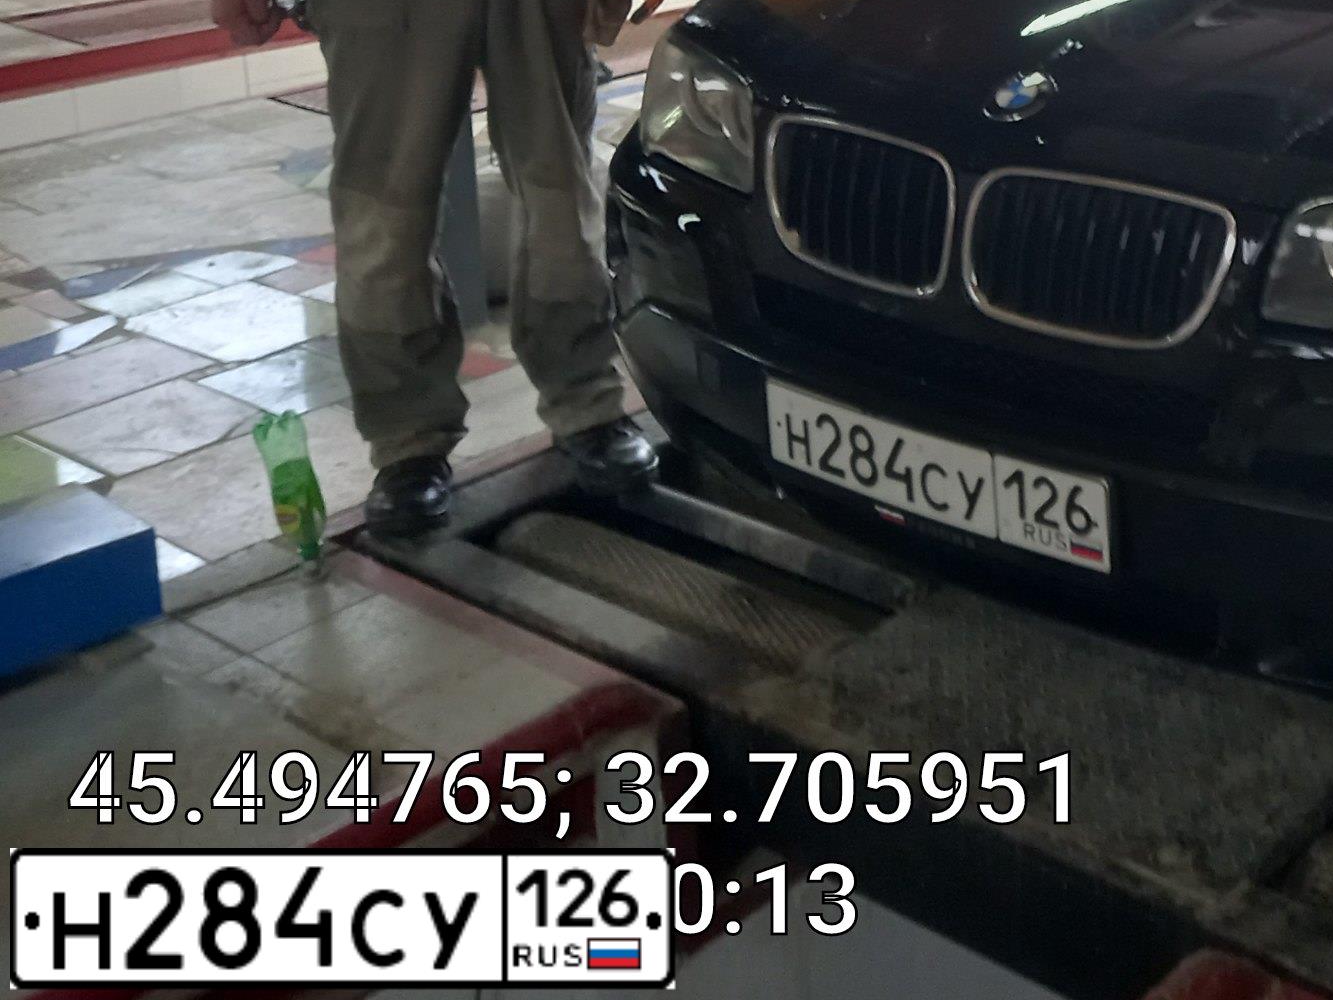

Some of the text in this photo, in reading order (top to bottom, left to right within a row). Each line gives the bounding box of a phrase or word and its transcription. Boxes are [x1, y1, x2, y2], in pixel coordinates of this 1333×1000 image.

[784, 412, 1099, 537] Н284СУ 126
[1023, 522, 1068, 552] RUS
